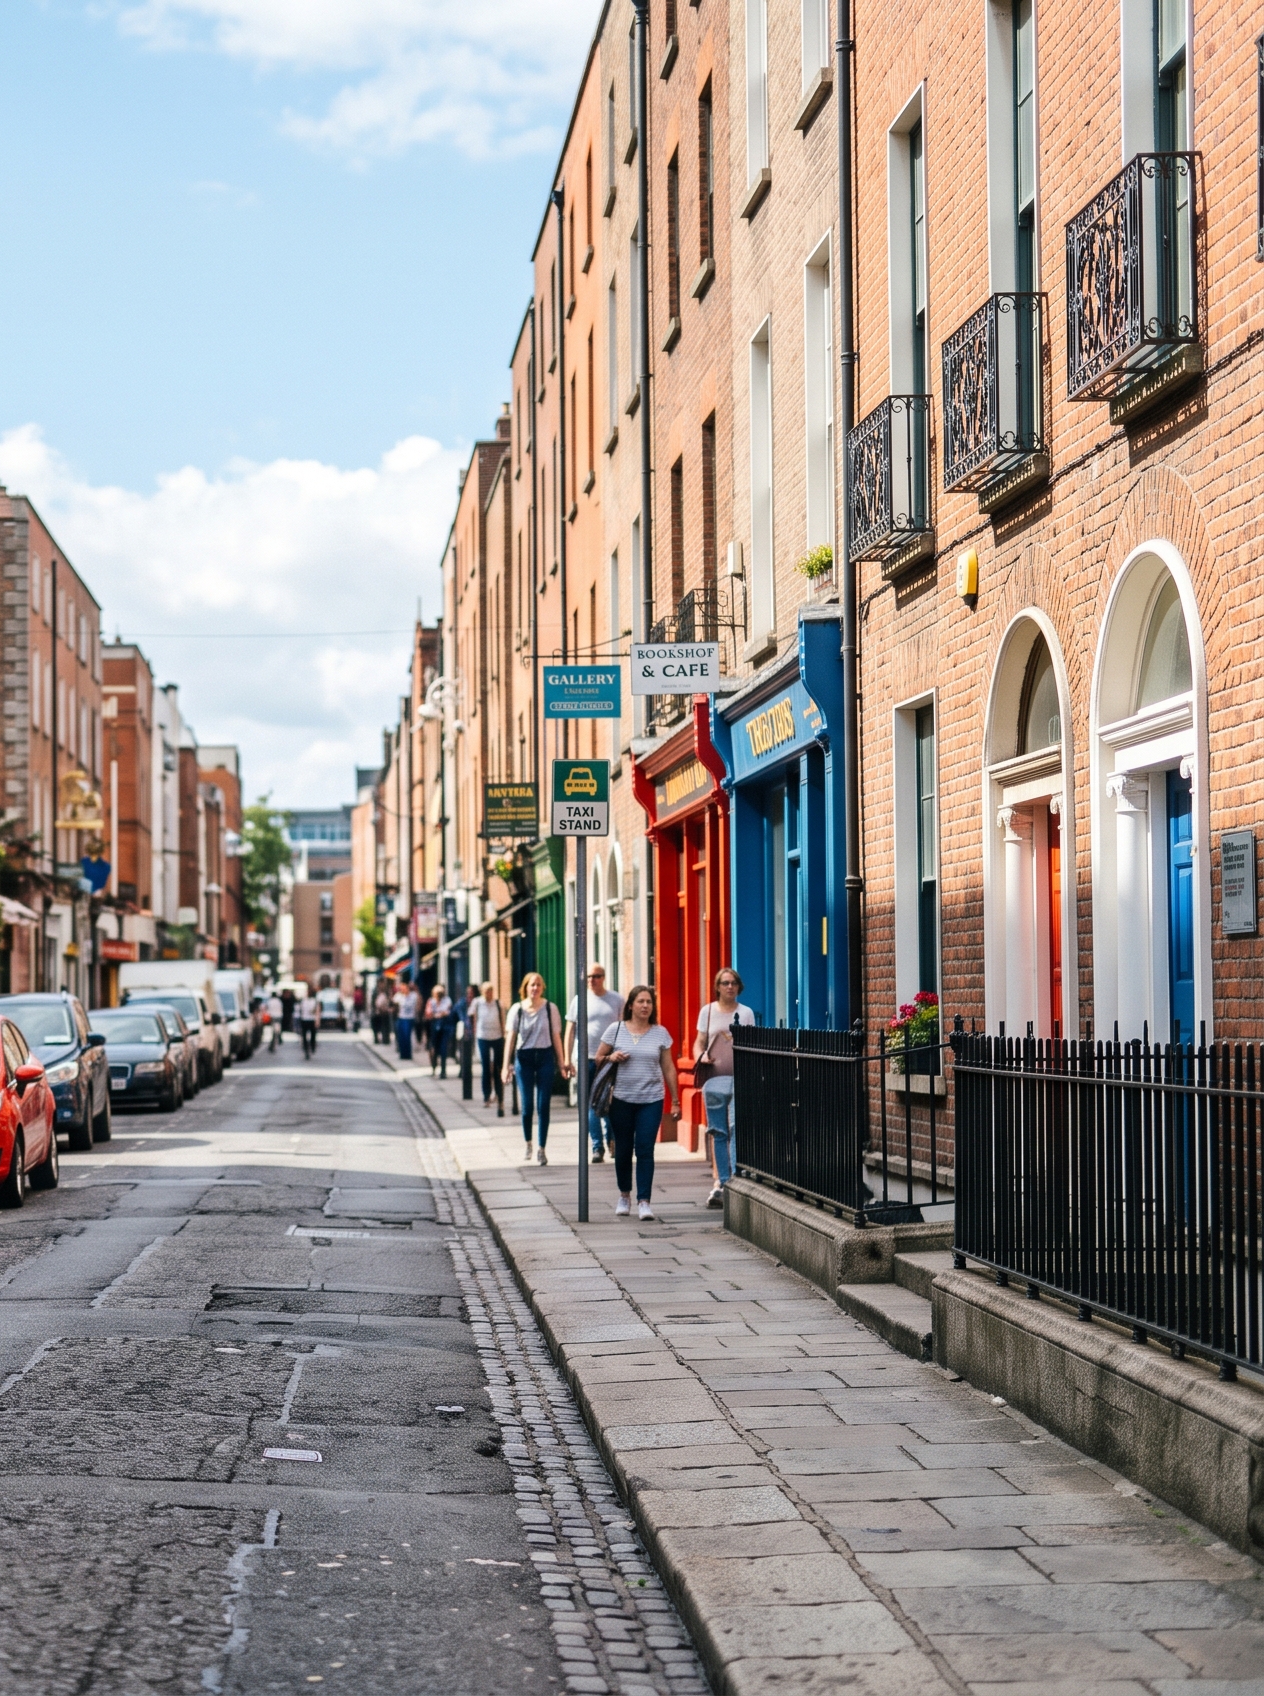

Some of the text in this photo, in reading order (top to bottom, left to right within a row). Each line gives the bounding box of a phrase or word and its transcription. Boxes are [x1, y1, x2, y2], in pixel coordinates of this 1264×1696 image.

[641, 663, 709, 678] & CAFE
[548, 674, 616, 686] GALLERY
[566, 806, 594, 818] TAXI
[559, 819, 602, 831] STAND
